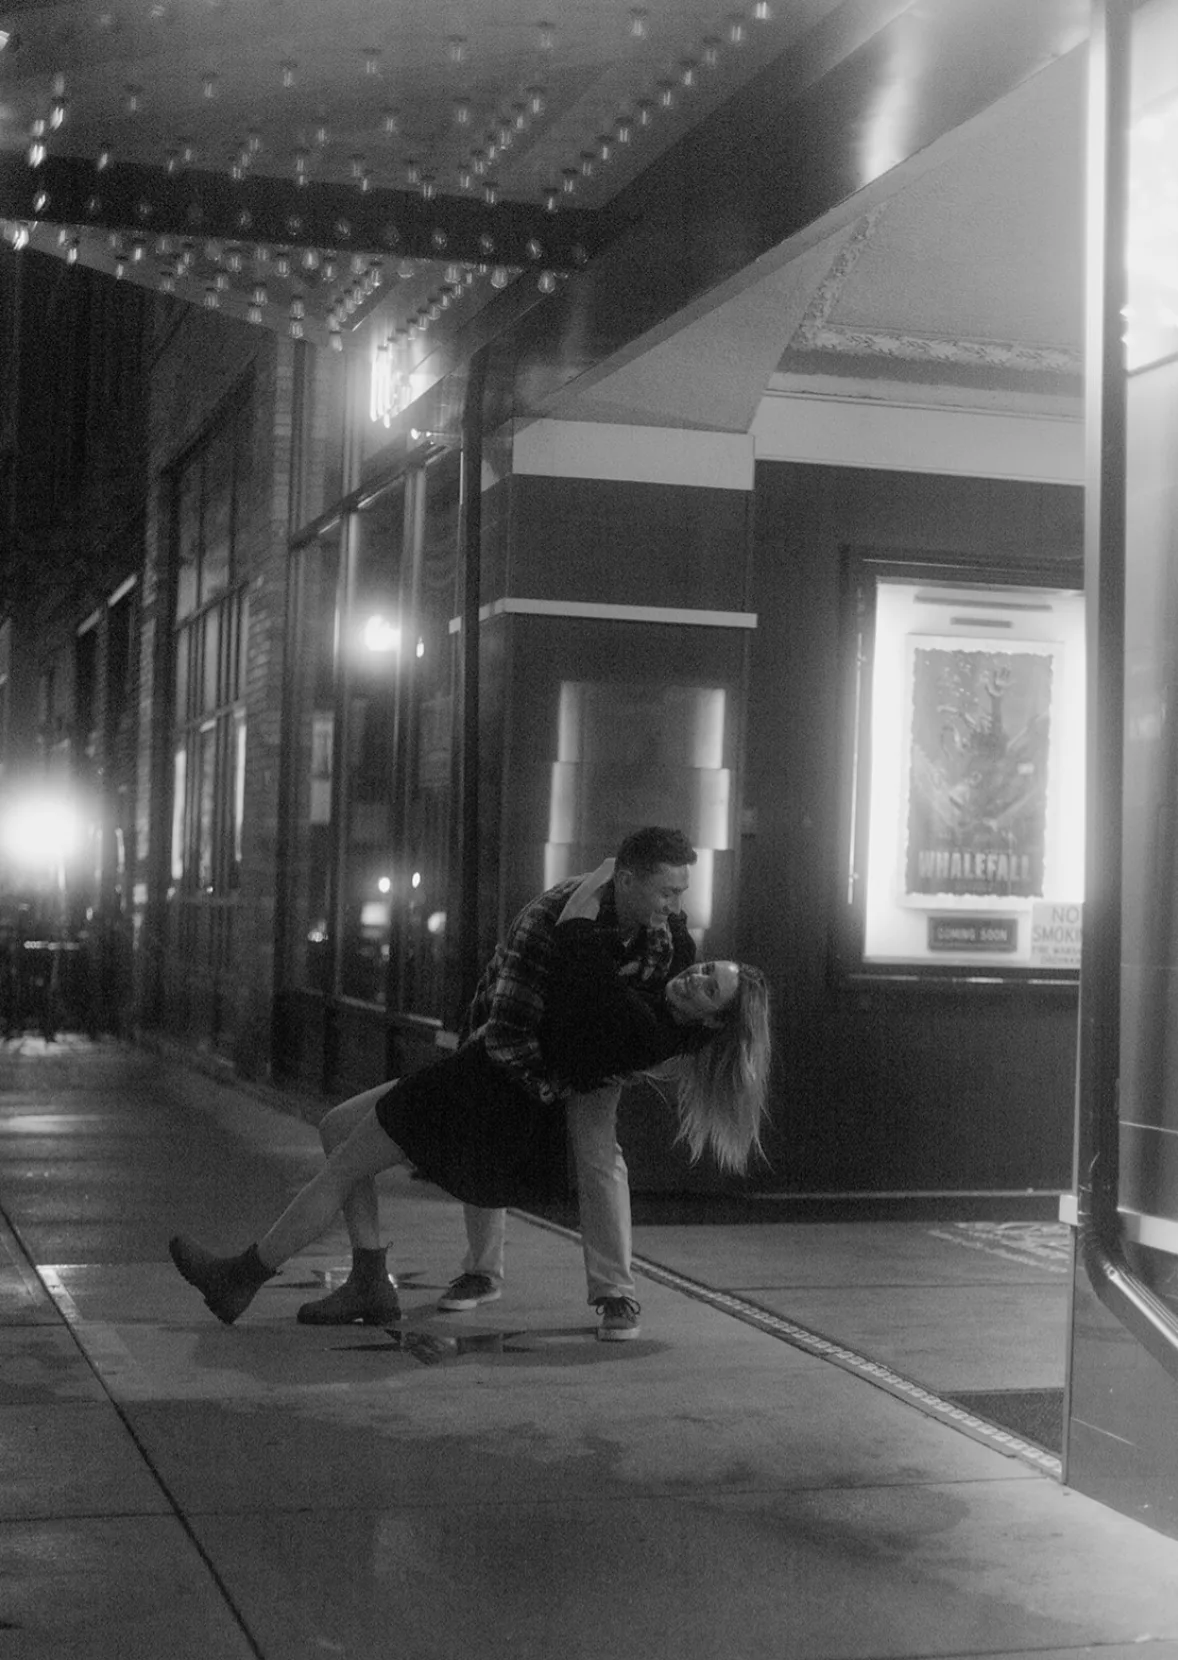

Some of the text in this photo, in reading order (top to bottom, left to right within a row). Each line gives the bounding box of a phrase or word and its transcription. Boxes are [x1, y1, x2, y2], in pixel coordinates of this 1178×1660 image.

[918, 850, 1031, 882] WHALEFALL
[1051, 906, 1080, 924] NO
[1032, 925, 1082, 944] SMOKI
